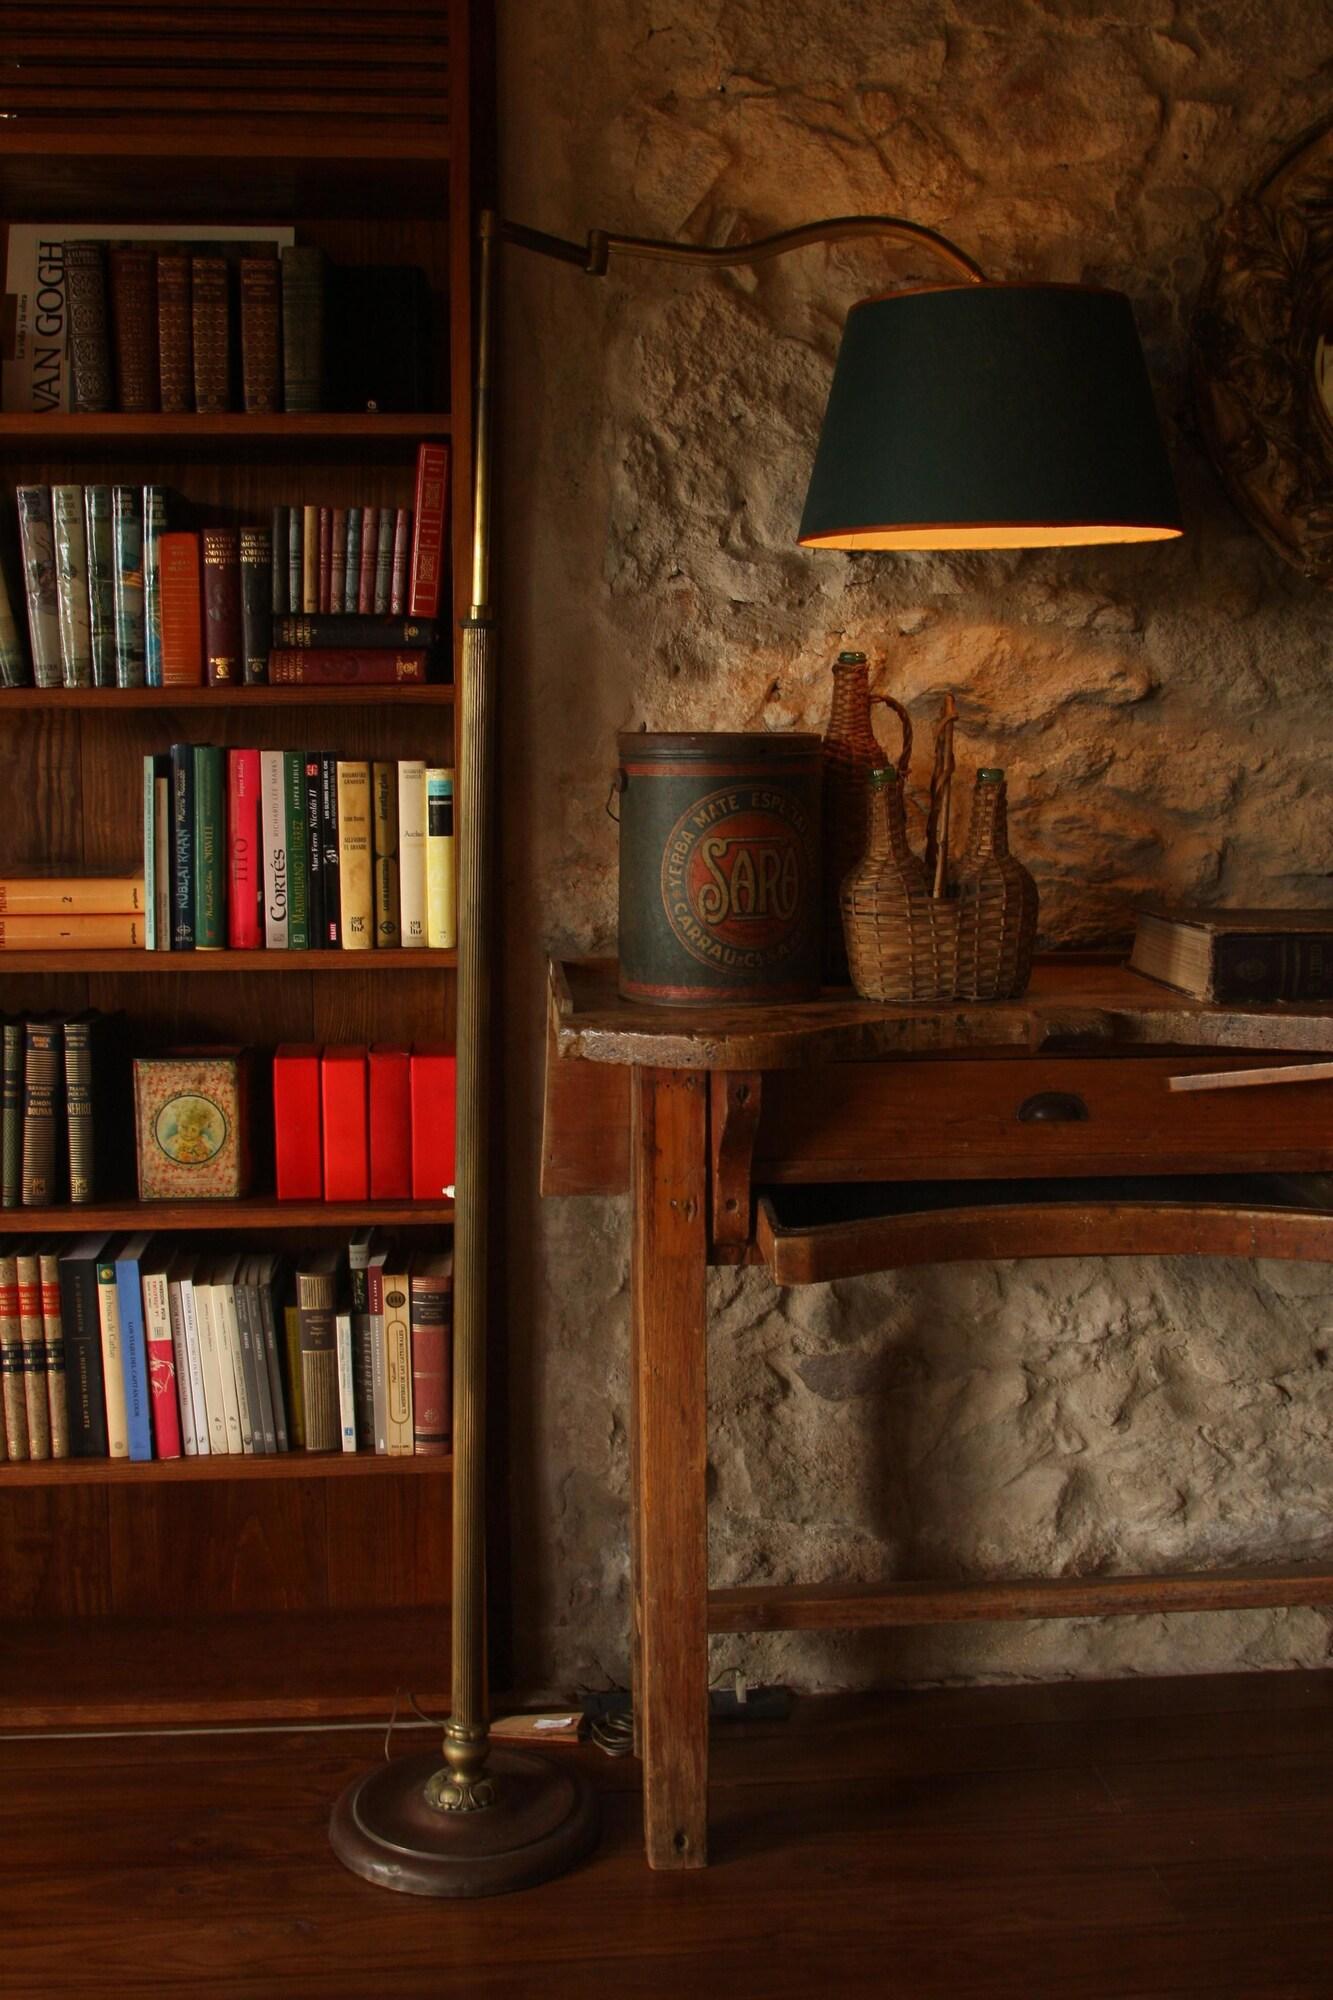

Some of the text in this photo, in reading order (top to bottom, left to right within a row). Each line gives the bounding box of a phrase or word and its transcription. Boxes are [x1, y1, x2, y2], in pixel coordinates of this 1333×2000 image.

[33, 241, 65, 413] VAN GOGH
[177, 829, 190, 863] KHAN
[236, 838, 249, 882] TITO
[308, 788, 320, 872] Marc Ferro Nicolás II
[668, 830, 696, 888] YERBA
[691, 793, 740, 828] MATE
[177, 866, 190, 909] KUBLAI
[270, 848, 286, 922] CORTÉS
[292, 862, 304, 924] MAXIMILIANO
[699, 837, 799, 925] SARA
[674, 902, 737, 966] CARRAU
